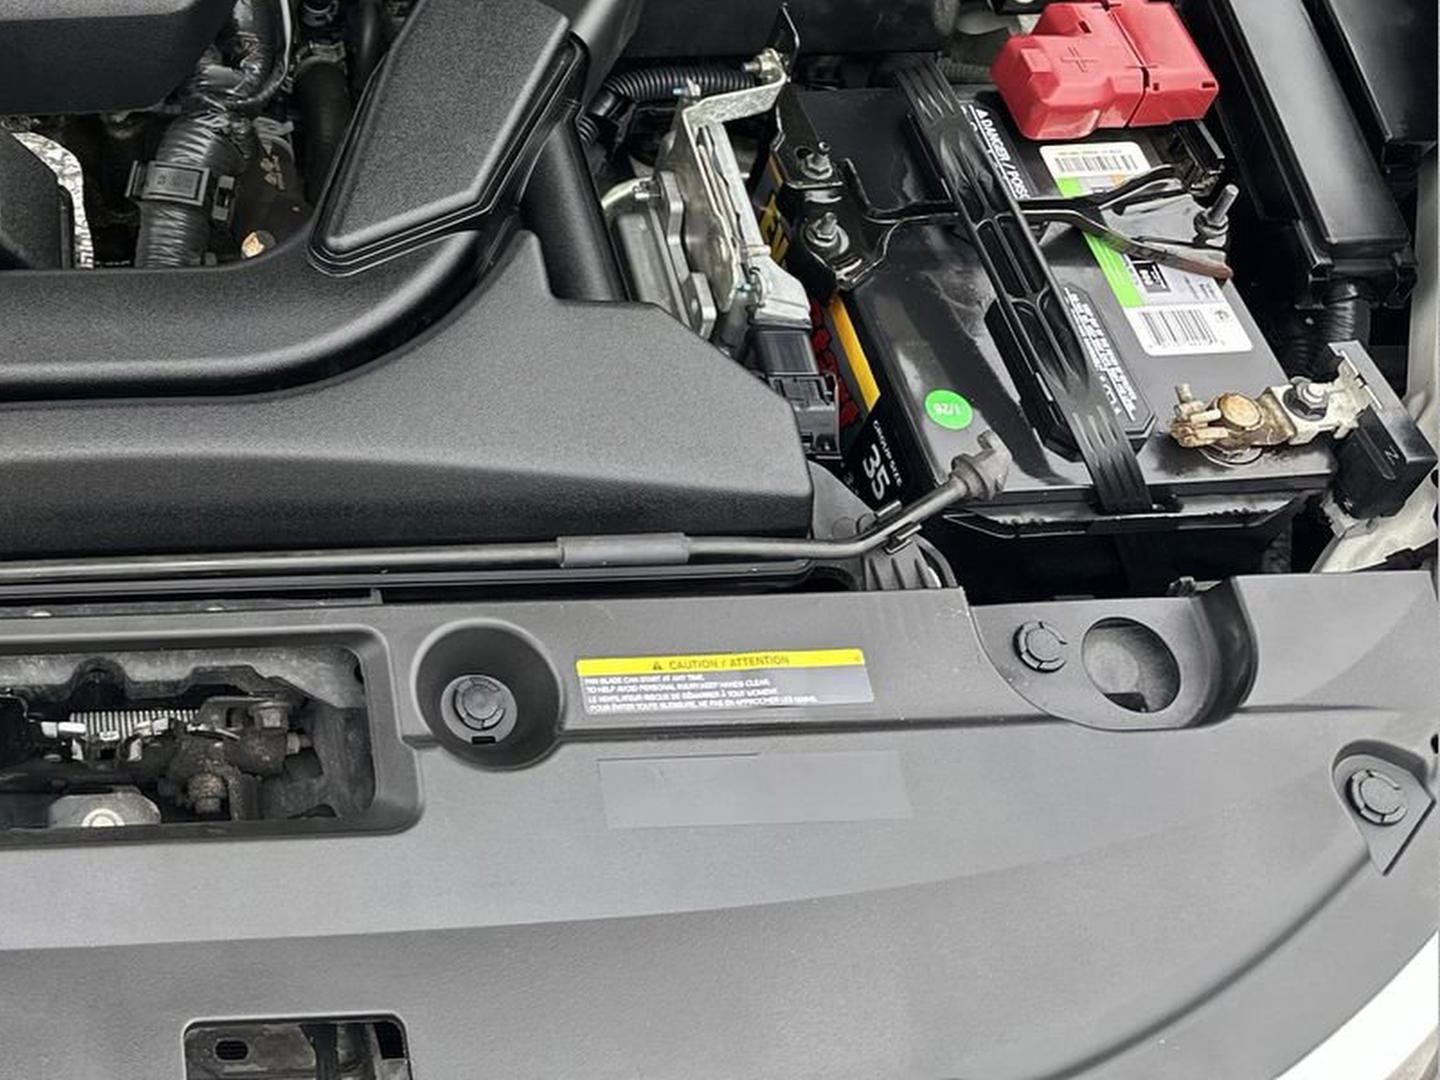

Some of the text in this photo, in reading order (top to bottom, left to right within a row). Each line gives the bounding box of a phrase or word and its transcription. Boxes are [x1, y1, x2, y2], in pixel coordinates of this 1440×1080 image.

[980, 119, 1011, 161] DANGER
[862, 443, 890, 500] 35
[669, 659, 718, 670] CAUTION
[730, 655, 790, 667] ATTENTION
